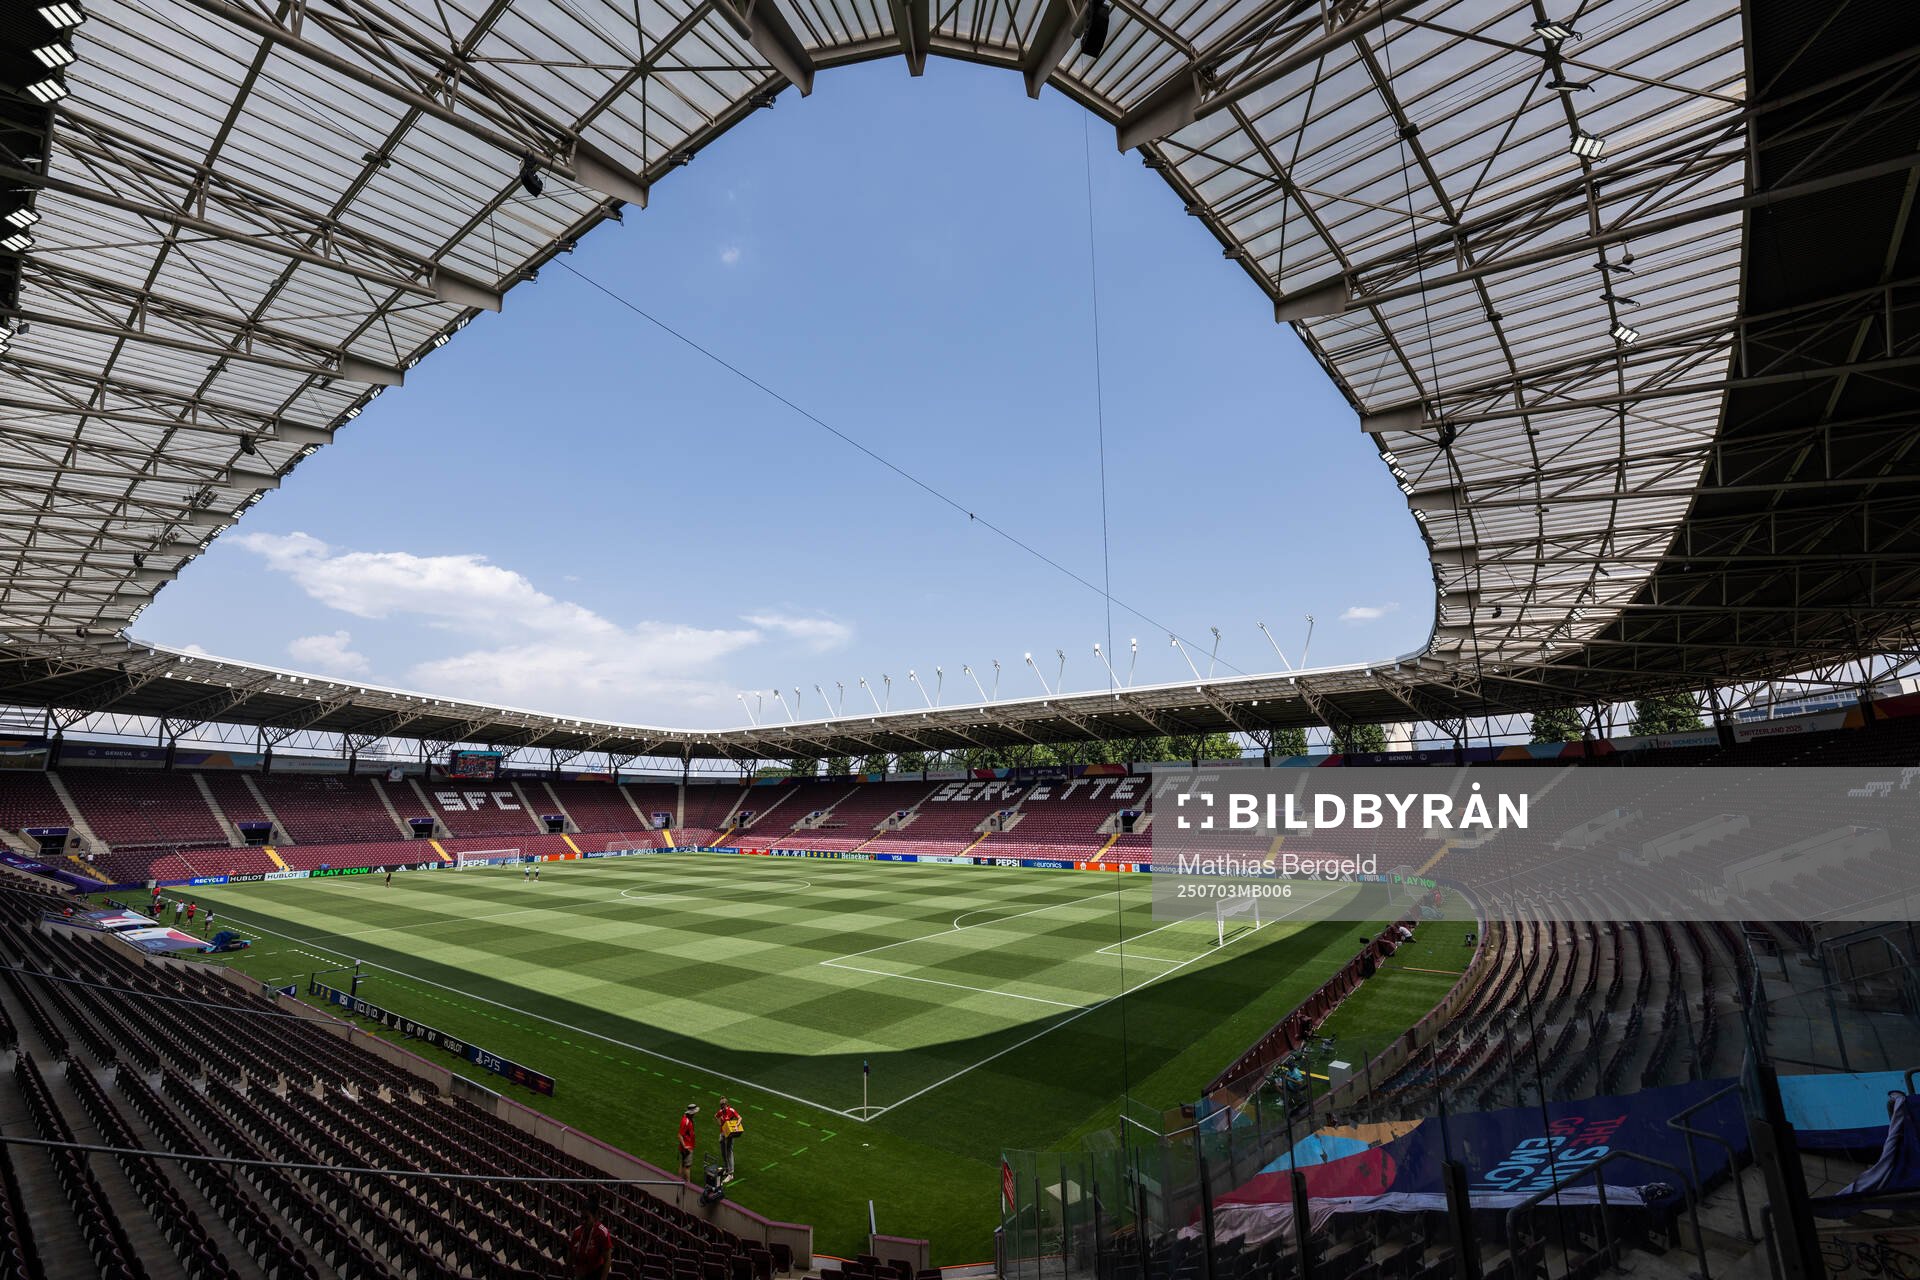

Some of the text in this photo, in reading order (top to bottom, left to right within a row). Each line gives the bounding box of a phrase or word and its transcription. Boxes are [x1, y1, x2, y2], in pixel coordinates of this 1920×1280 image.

[932, 777, 1146, 802] SERVETTE
[434, 791, 521, 812] SFC
[841, 852, 870, 860] Heineken
[461, 859, 489, 867] PEPSI
[995, 858, 1020, 867] PEPSI
[1036, 861, 1063, 869] euronics
[267, 872, 298, 880] HUBLOT
[313, 867, 369, 877] PLAY NOW
[194, 876, 225, 884] RECYCLE
[230, 874, 263, 882] HUBLOT
[1394, 875, 1419, 885] PAY
[483, 1055, 501, 1072] PS5
